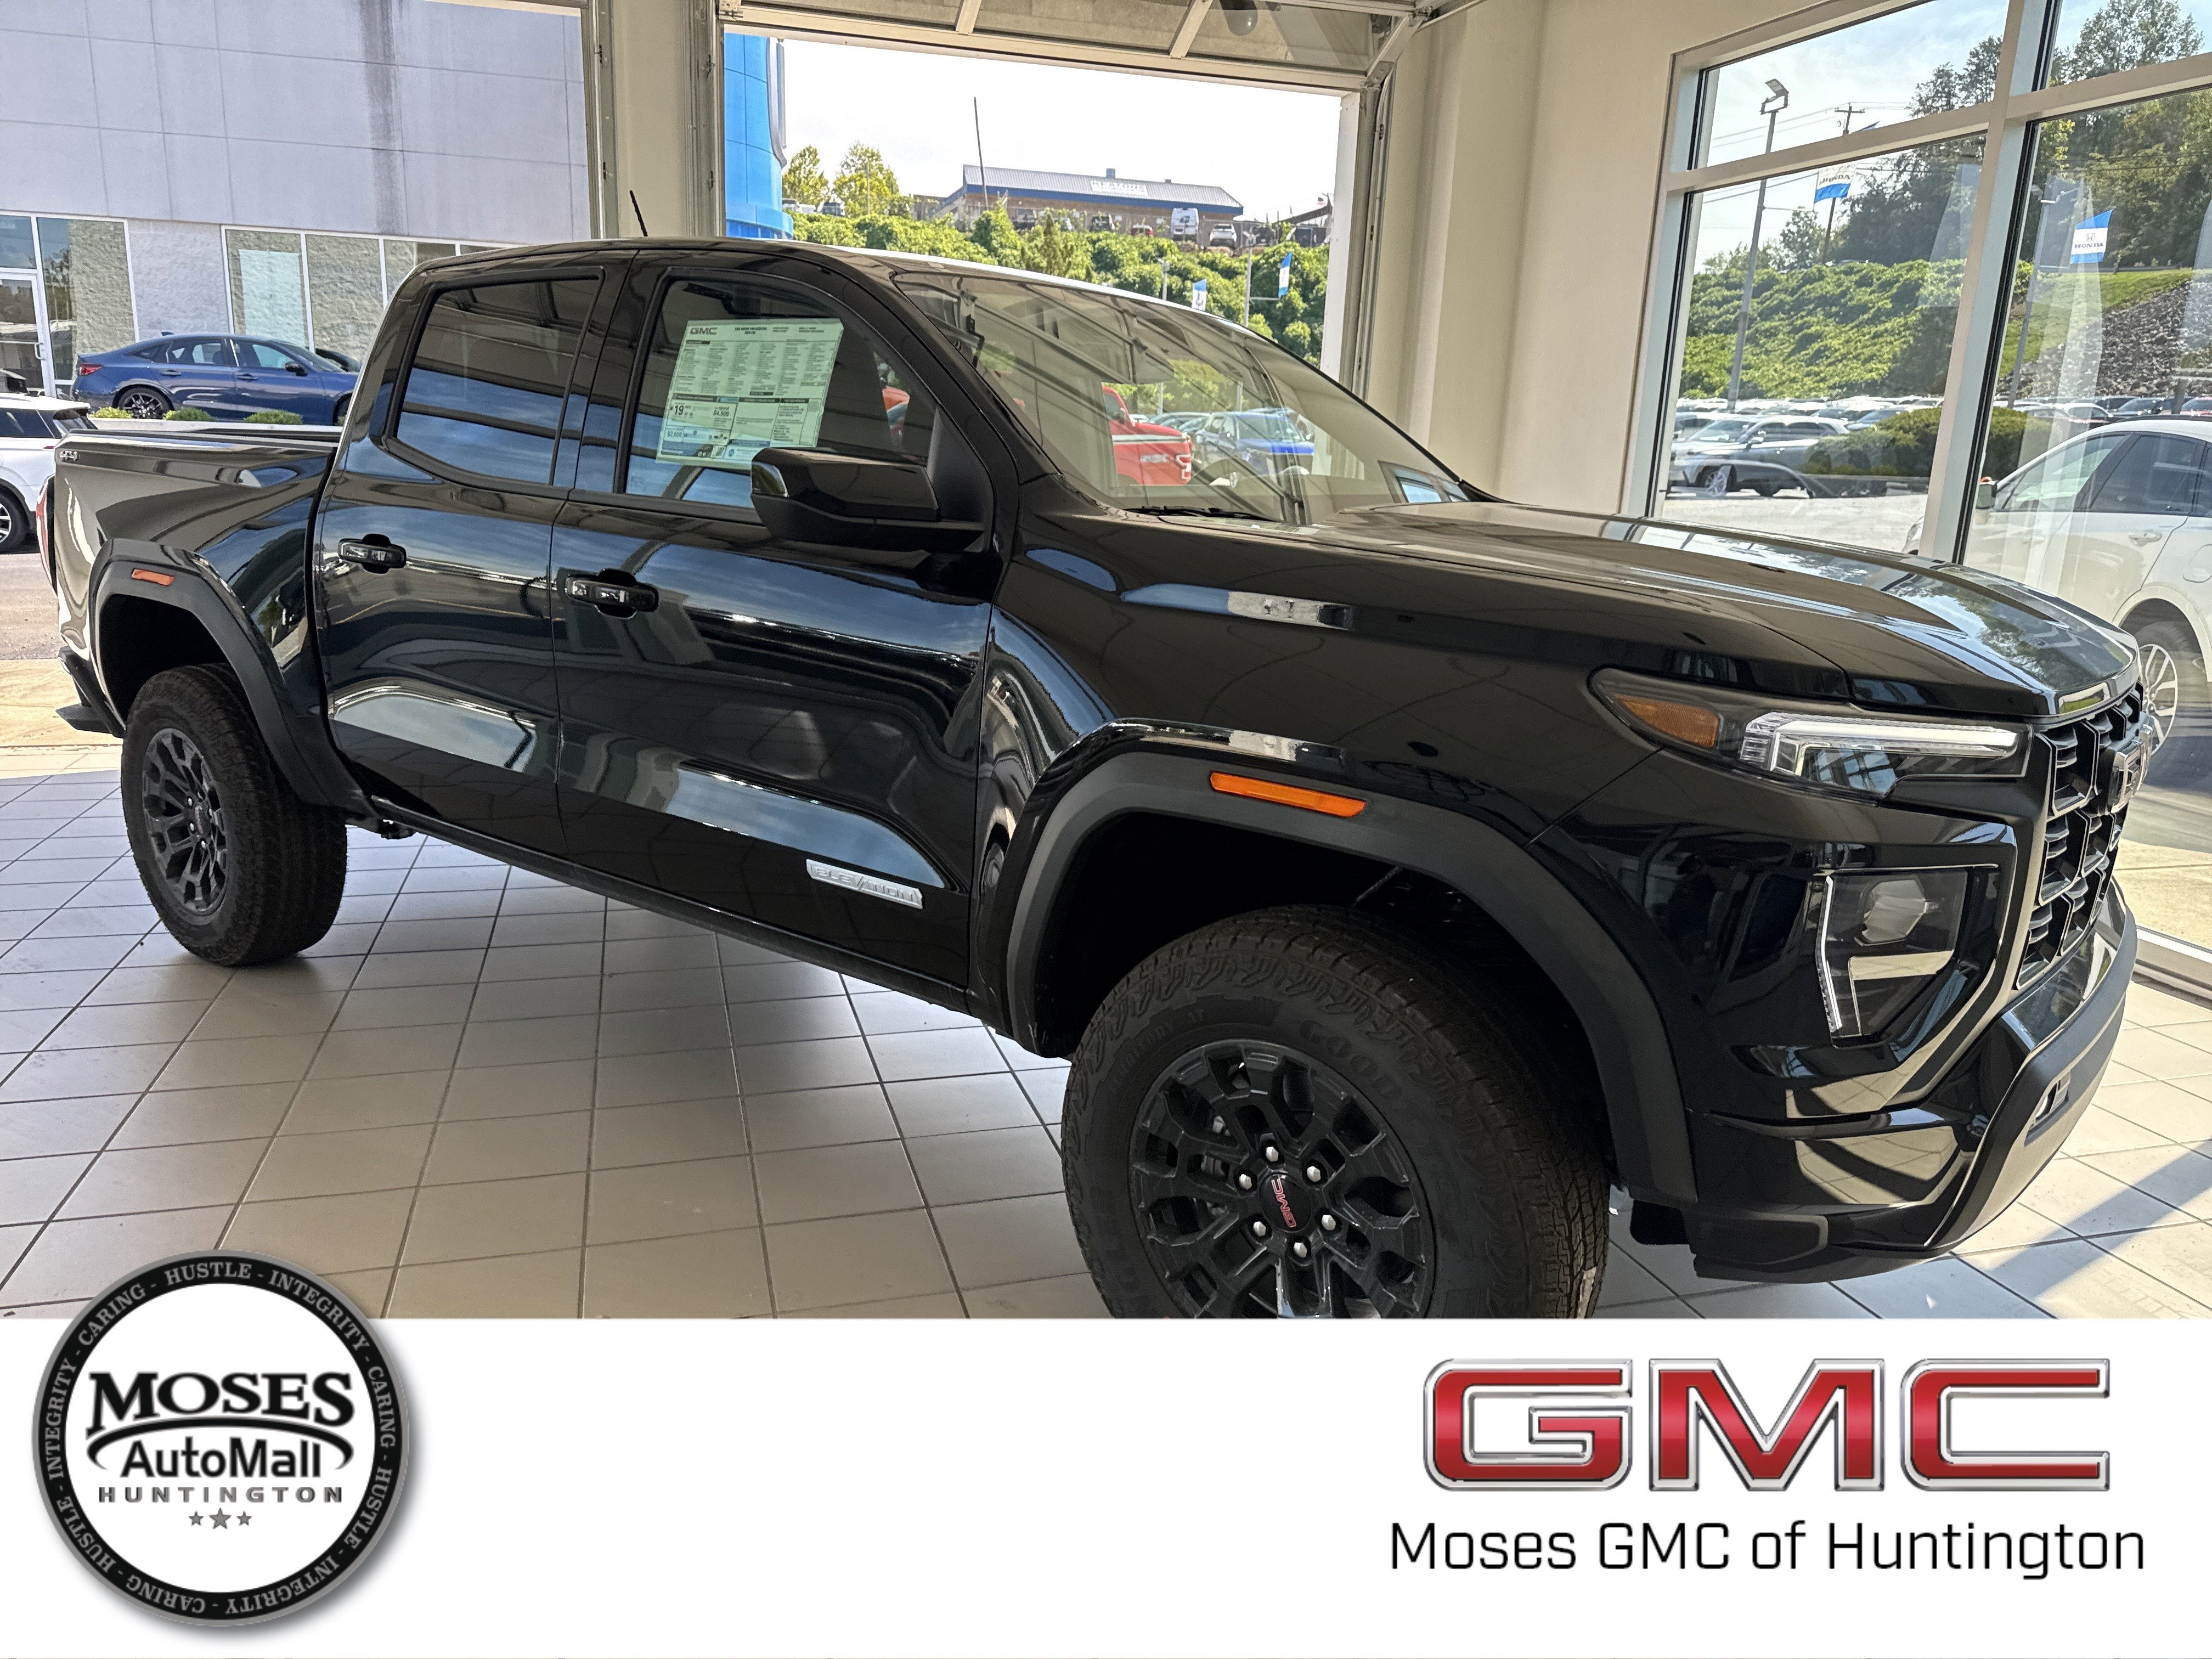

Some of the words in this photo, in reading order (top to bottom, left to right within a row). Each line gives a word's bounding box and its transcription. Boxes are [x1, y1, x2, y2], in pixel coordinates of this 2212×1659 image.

[1819, 174, 1850, 185] HONDA
[674, 405, 684, 415] 19
[815, 865, 915, 902] ELEVATION
[1271, 1178, 1297, 1228] GMC
